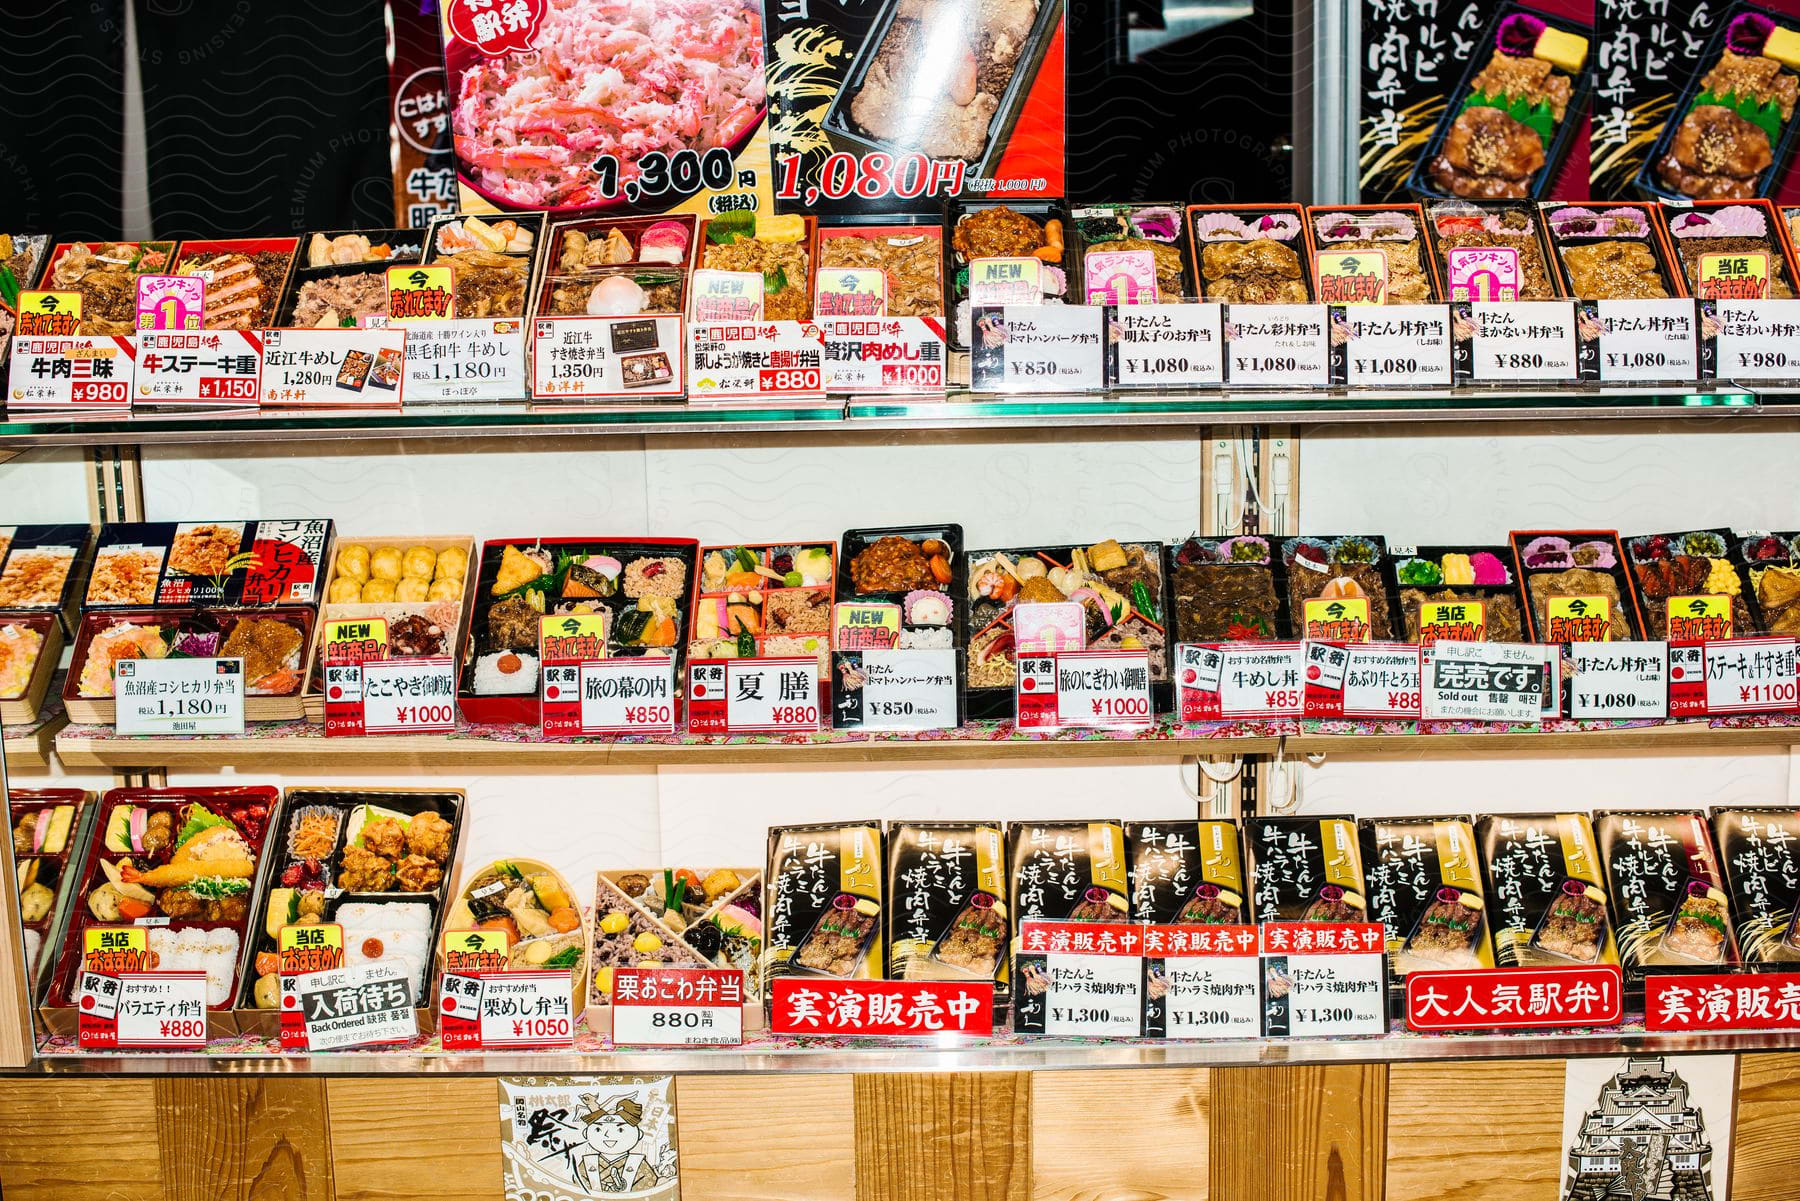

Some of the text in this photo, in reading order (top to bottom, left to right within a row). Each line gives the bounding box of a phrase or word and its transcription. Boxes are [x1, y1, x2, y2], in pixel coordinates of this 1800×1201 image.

[591, 147, 757, 203] 1,300円
[776, 151, 967, 206] 1,080円
[1340, 257, 1360, 273] 今
[1718, 259, 1748, 275] 当店
[409, 271, 429, 288] 今
[708, 279, 744, 294] NEW
[839, 274, 860, 291] 今
[1125, 316, 1171, 328] 牛たんと
[1478, 312, 1514, 324] 牛たん
[1723, 310, 1759, 322] 牛たん
[1008, 322, 1036, 331] 牛たん
[1235, 323, 1320, 338] 牛たん彩丼弁当
[1352, 321, 1443, 336] 牛たん丼弁当
[1479, 325, 1564, 339] まかない丼弁当
[1604, 317, 1689, 332] 牛たん丼弁当
[563, 332, 592, 344] 近江牛
[1124, 330, 1211, 343] 明太子のお弁当
[265, 350, 341, 366] 近江牛めし
[405, 342, 510, 360] 黒毛和牛 牛めし
[550, 348, 605, 360] すき焼き弁当
[825, 342, 941, 361] 贅沢肉めし重
[143, 355, 256, 375] 牛ステーキ重
[1011, 361, 1057, 375] ¥850
[1127, 358, 1188, 374] ¥1,080
[1236, 357, 1320, 373] ¥1,080 (税込み)
[1355, 359, 1443, 375] ¥1,080 (税込み)
[1495, 354, 1543, 368] ¥880
[1607, 353, 1665, 368] ¥1,080
[1738, 352, 1786, 368] ¥980
[32, 358, 113, 379] 牛肉三昧
[413, 362, 506, 381] 税込 1,180円
[552, 364, 603, 379] 1,350円
[284, 371, 332, 386] 1,280円
[762, 371, 819, 389] ¥880
[73, 384, 126, 400] ¥980
[201, 380, 254, 398] ¥1,150
[296, 520, 324, 566] 魚沼産
[268, 520, 300, 599] コシヒカリ
[1326, 603, 1346, 618] 今
[1436, 606, 1465, 621] 当店
[1568, 599, 1587, 615] 今
[1689, 599, 1709, 615] 今
[849, 611, 884, 624] NEW
[337, 624, 370, 639] NEW
[562, 618, 581, 634] 今
[1227, 655, 1292, 665] おすすめ名物弁当
[1353, 655, 1416, 665] おすすめ名物弁当
[1578, 657, 1661, 672] 牛たん丼弁当
[1707, 651, 1795, 680] ステーキ&牛すき重
[867, 664, 893, 674] 牛たん
[1439, 662, 1540, 692] 完売です。
[364, 675, 452, 697] たこやき御飯
[1060, 668, 1146, 691] 旅のにぎわい御膳
[1232, 670, 1298, 688] 牛めし丼
[125, 680, 235, 695] 魚沼産コシヒカリ弁当
[585, 677, 667, 699] 旅の幕の内
[1740, 683, 1795, 702] ¥1100
[1438, 691, 1460, 701] Sold
[1462, 693, 1478, 702] out
[1519, 694, 1537, 704] 매진
[1579, 693, 1635, 709] ¥1,080
[158, 699, 226, 716] 1,180円
[397, 705, 452, 723] ¥1000
[626, 705, 670, 723] ¥850
[773, 705, 817, 723] ¥880
[870, 701, 913, 715] ¥850
[1092, 698, 1148, 715] ¥1000
[1441, 706, 1534, 717] またの機会にお願いします。
[1166, 833, 1196, 896] 牛たんと
[1528, 826, 1556, 893] 牛たんと
[1648, 827, 1678, 891] 牛たんと
[1767, 824, 1799, 889] 牛たんと
[940, 840, 971, 905] 牛たんと
[1054, 836, 1085, 899] 牛たんと
[1287, 832, 1317, 898] 牛たんと
[1403, 835, 1433, 901] 牛たんと
[804, 843, 835, 907] 牛たんと
[1491, 858, 1527, 933] 焼肉弁当
[1612, 852, 1651, 932] 焼肉弁当
[1733, 852, 1773, 929] 焼肉弁当
[768, 873, 794, 950] 焼肉弁当
[901, 868, 930, 945] 焼肉弁当
[1366, 865, 1399, 942] 焼肉弁当
[101, 933, 129, 947] 当店
[296, 930, 324, 944] 当店
[464, 934, 485, 950] 今
[1027, 929, 1139, 952] 実演販売中
[1146, 930, 1255, 952] 実演販売中
[1269, 927, 1380, 950] 実演販売中
[1052, 968, 1094, 980] 牛たんと
[1170, 971, 1212, 982] 牛たんと
[1293, 968, 1335, 980] 牛たんと
[488, 984, 537, 994] おすすめ弁当
[617, 974, 740, 1002] 栗おこわ弁当
[1051, 983, 1136, 995] 牛ハラミ焼肉弁当
[1170, 984, 1255, 996] 牛ハラミ焼肉弁当
[1293, 981, 1378, 993] 牛ハラミ焼肉弁当
[311, 981, 406, 1020] 入荷待ち
[484, 996, 568, 1017] 栗めし弁当
[1415, 981, 1610, 1018] 大人気駅弁!
[1658, 982, 1800, 1025] 実演販売
[119, 1000, 201, 1016] バラエティ弁当
[787, 988, 980, 1029] 実演販売中
[1052, 1008, 1110, 1023] ¥1,300
[1295, 1007, 1353, 1024] ¥1,300
[311, 1023, 331, 1033] Back
[331, 1017, 365, 1031] Ordered
[391, 1008, 410, 1021] 품절
[652, 1012, 699, 1027] 880
[701, 1019, 713, 1027] 円
[1172, 1011, 1230, 1025] ¥1,300
[160, 1020, 203, 1037] ¥880
[513, 1019, 569, 1037] ¥1050
